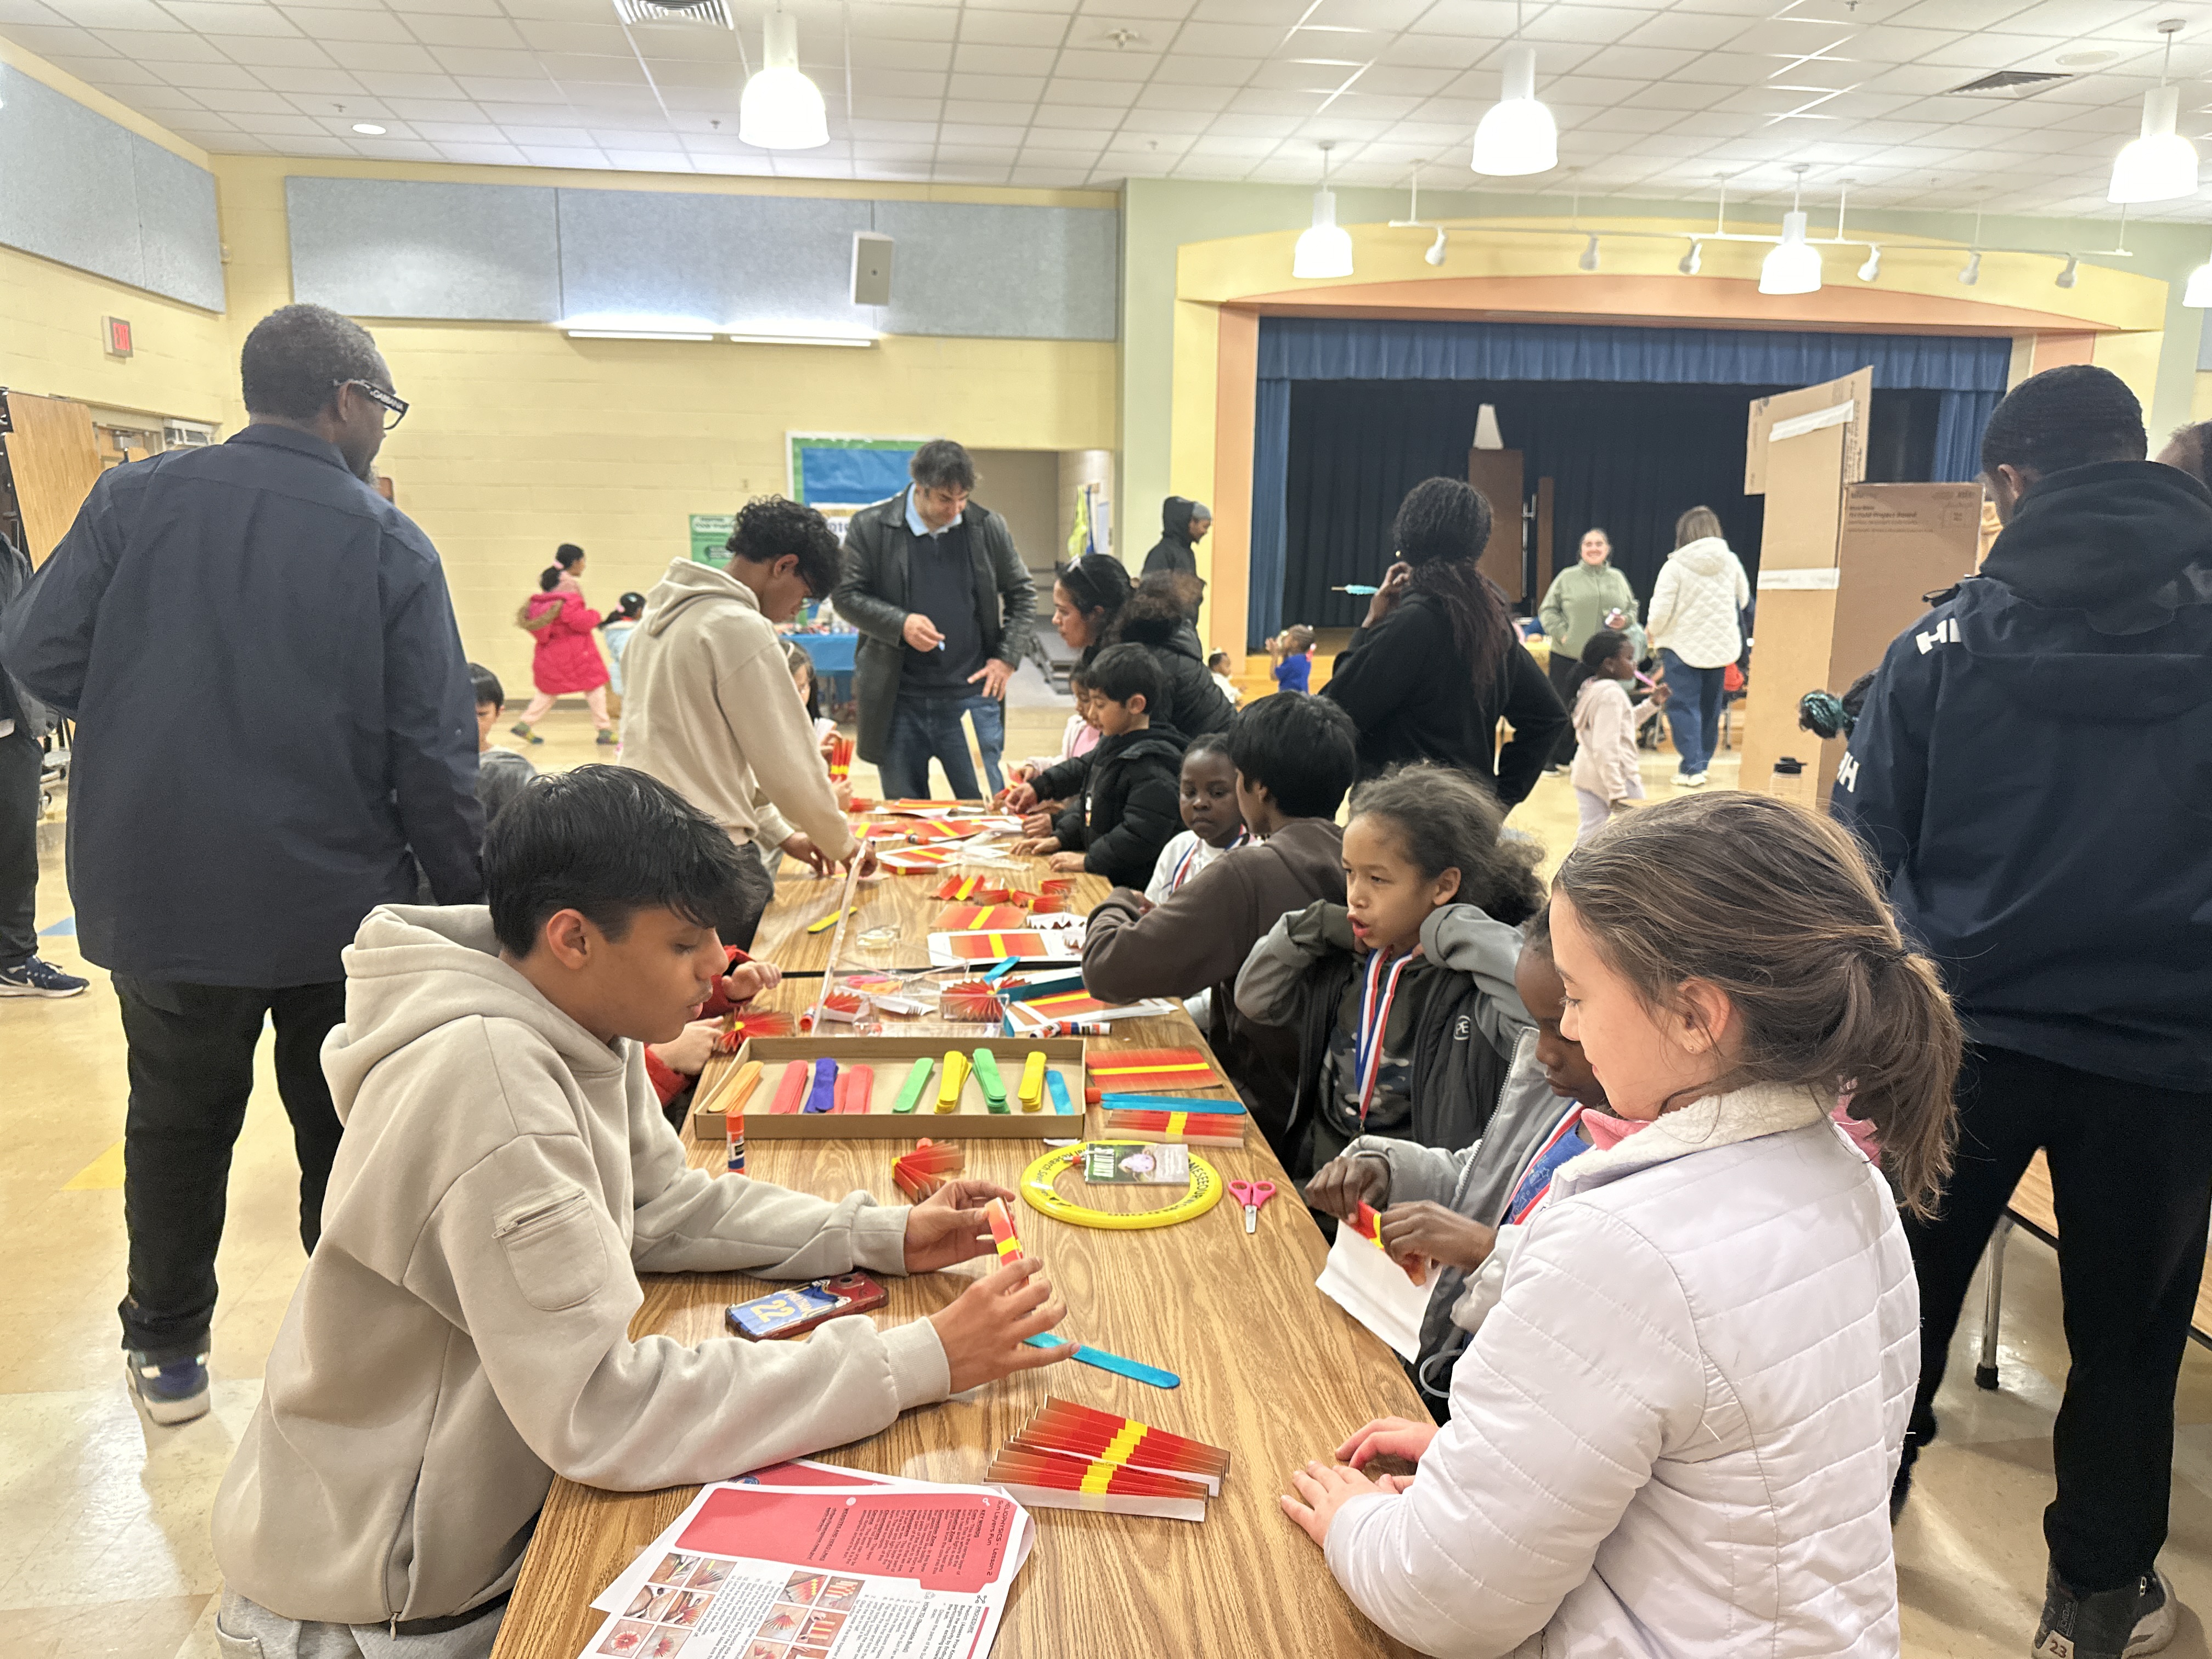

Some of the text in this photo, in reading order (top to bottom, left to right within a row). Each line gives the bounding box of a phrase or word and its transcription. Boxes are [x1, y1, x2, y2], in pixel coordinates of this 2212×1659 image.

[113, 323, 130, 351] EXIT
[751, 1300, 795, 1323] 22
[975, 1520, 983, 1538] WORDS
[990, 1512, 999, 1532] Layers
[996, 1502, 1011, 1541] HELIOPHYSICS
[989, 1548, 999, 1570] Lesson
[967, 1606, 981, 1634] PROCEDURE
[2050, 1639, 2067, 1658] 23
